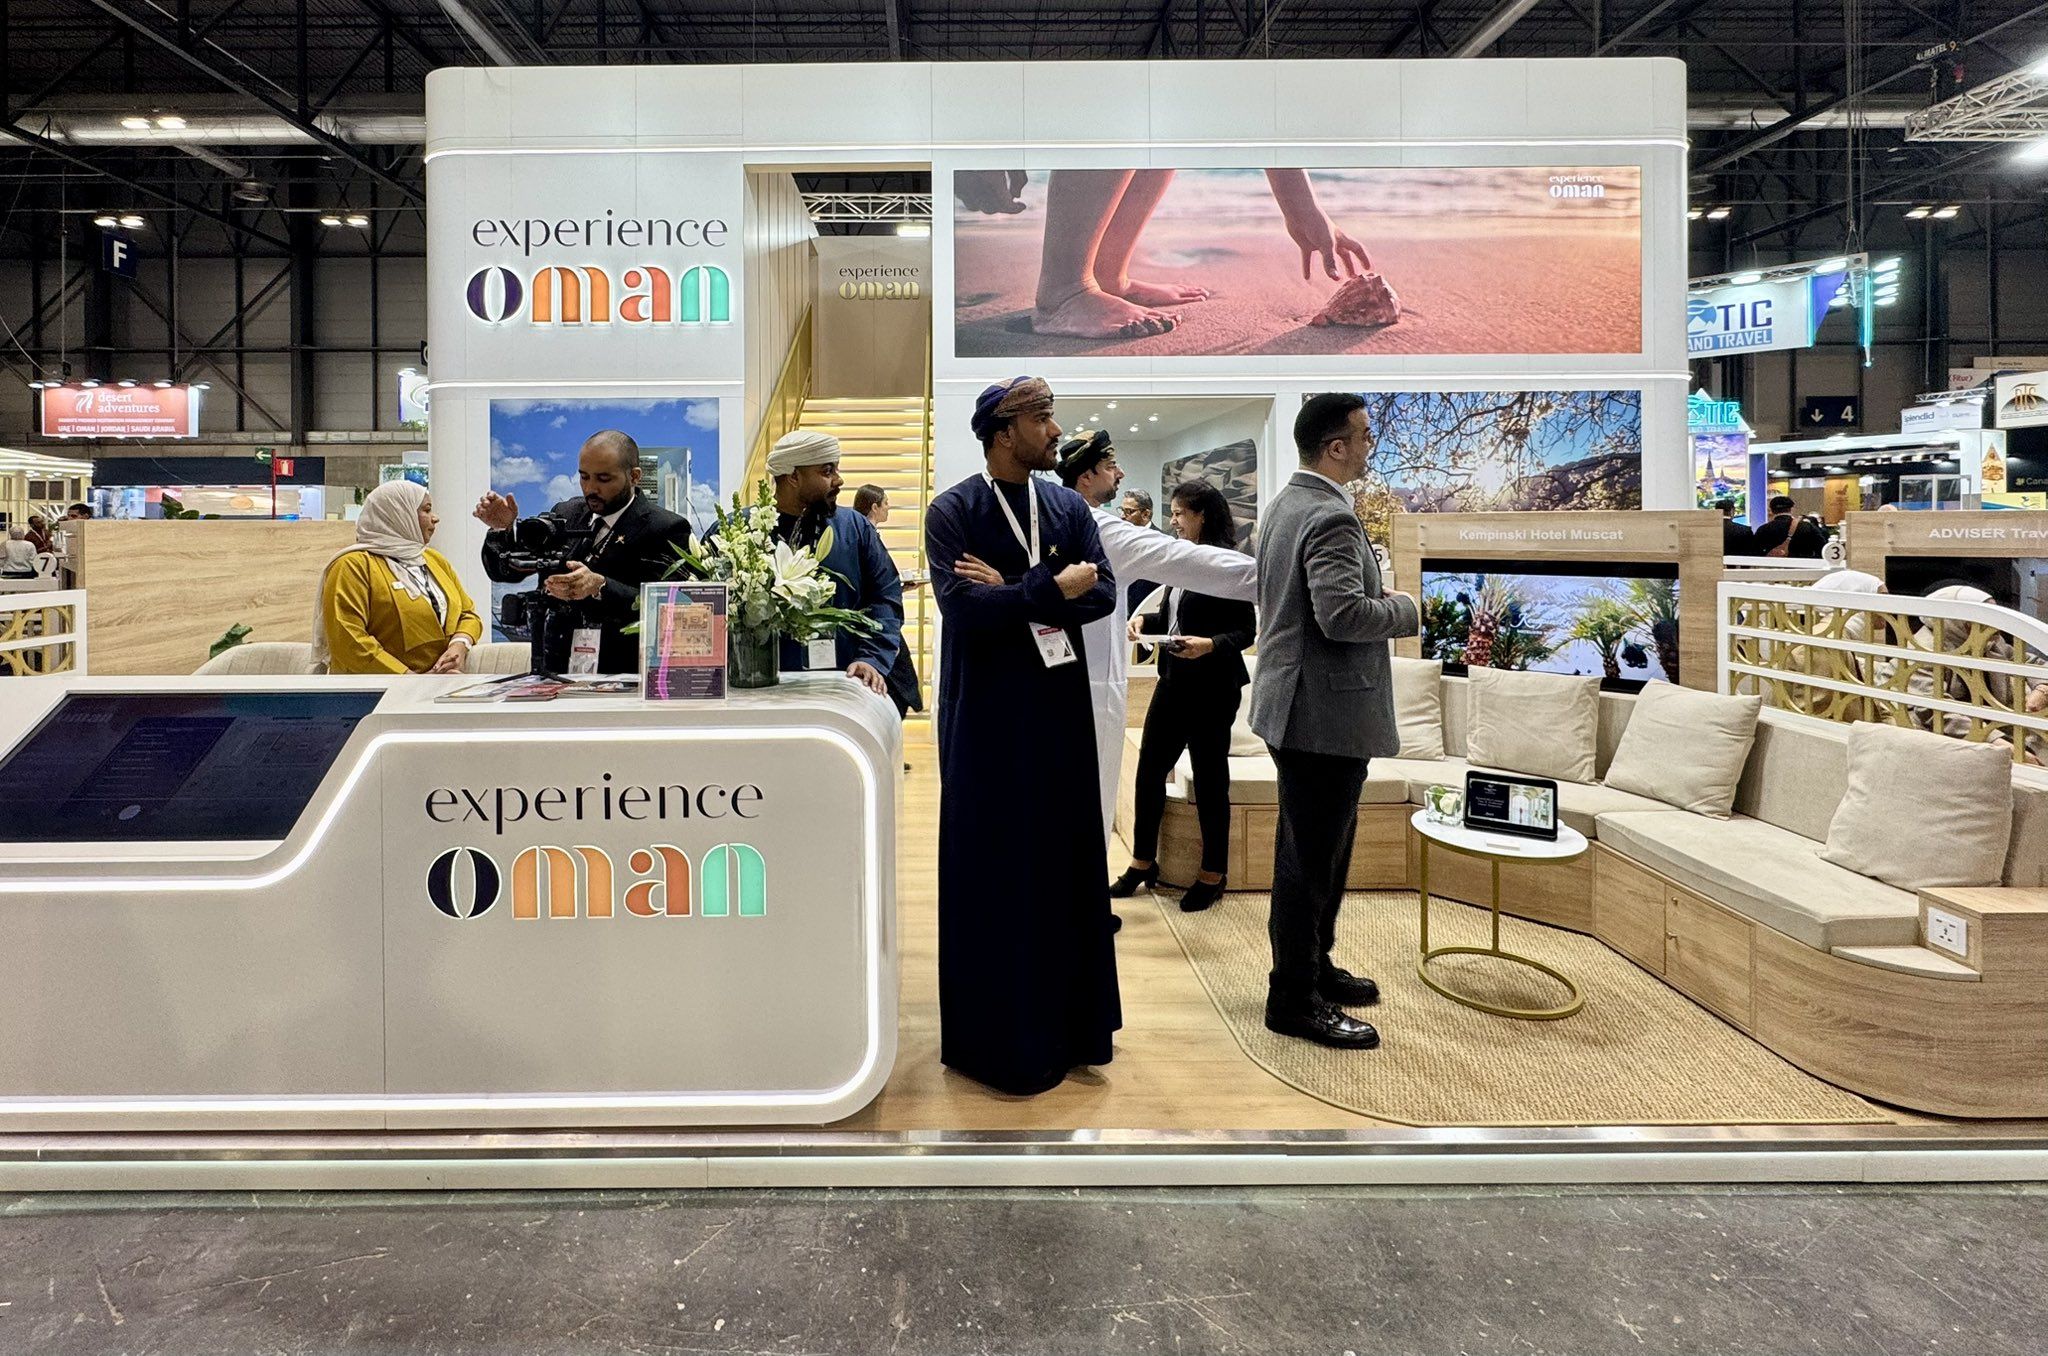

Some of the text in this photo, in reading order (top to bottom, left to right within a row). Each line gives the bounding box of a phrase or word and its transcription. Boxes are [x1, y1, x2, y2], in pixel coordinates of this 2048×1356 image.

[1549, 175, 1605, 184] experience
[1549, 184, 1605, 198] oman
[472, 209, 728, 256] experience
[113, 240, 127, 268] F
[839, 264, 919, 280] experience
[466, 266, 731, 323] oman
[839, 281, 919, 300] oman
[1717, 329, 1771, 348] TRAVEL
[98, 393, 132, 402] desert
[98, 402, 161, 413] adventures
[1841, 405, 1854, 422] 4
[1459, 529, 1624, 542] Kempinski Hotel Muscat
[1928, 528, 2006, 539] ADVISER
[1375, 548, 1383, 562] 5
[1831, 546, 1840, 560] 3
[40, 556, 50, 572] 7
[425, 773, 763, 835] experience
[426, 844, 766, 919] oman
